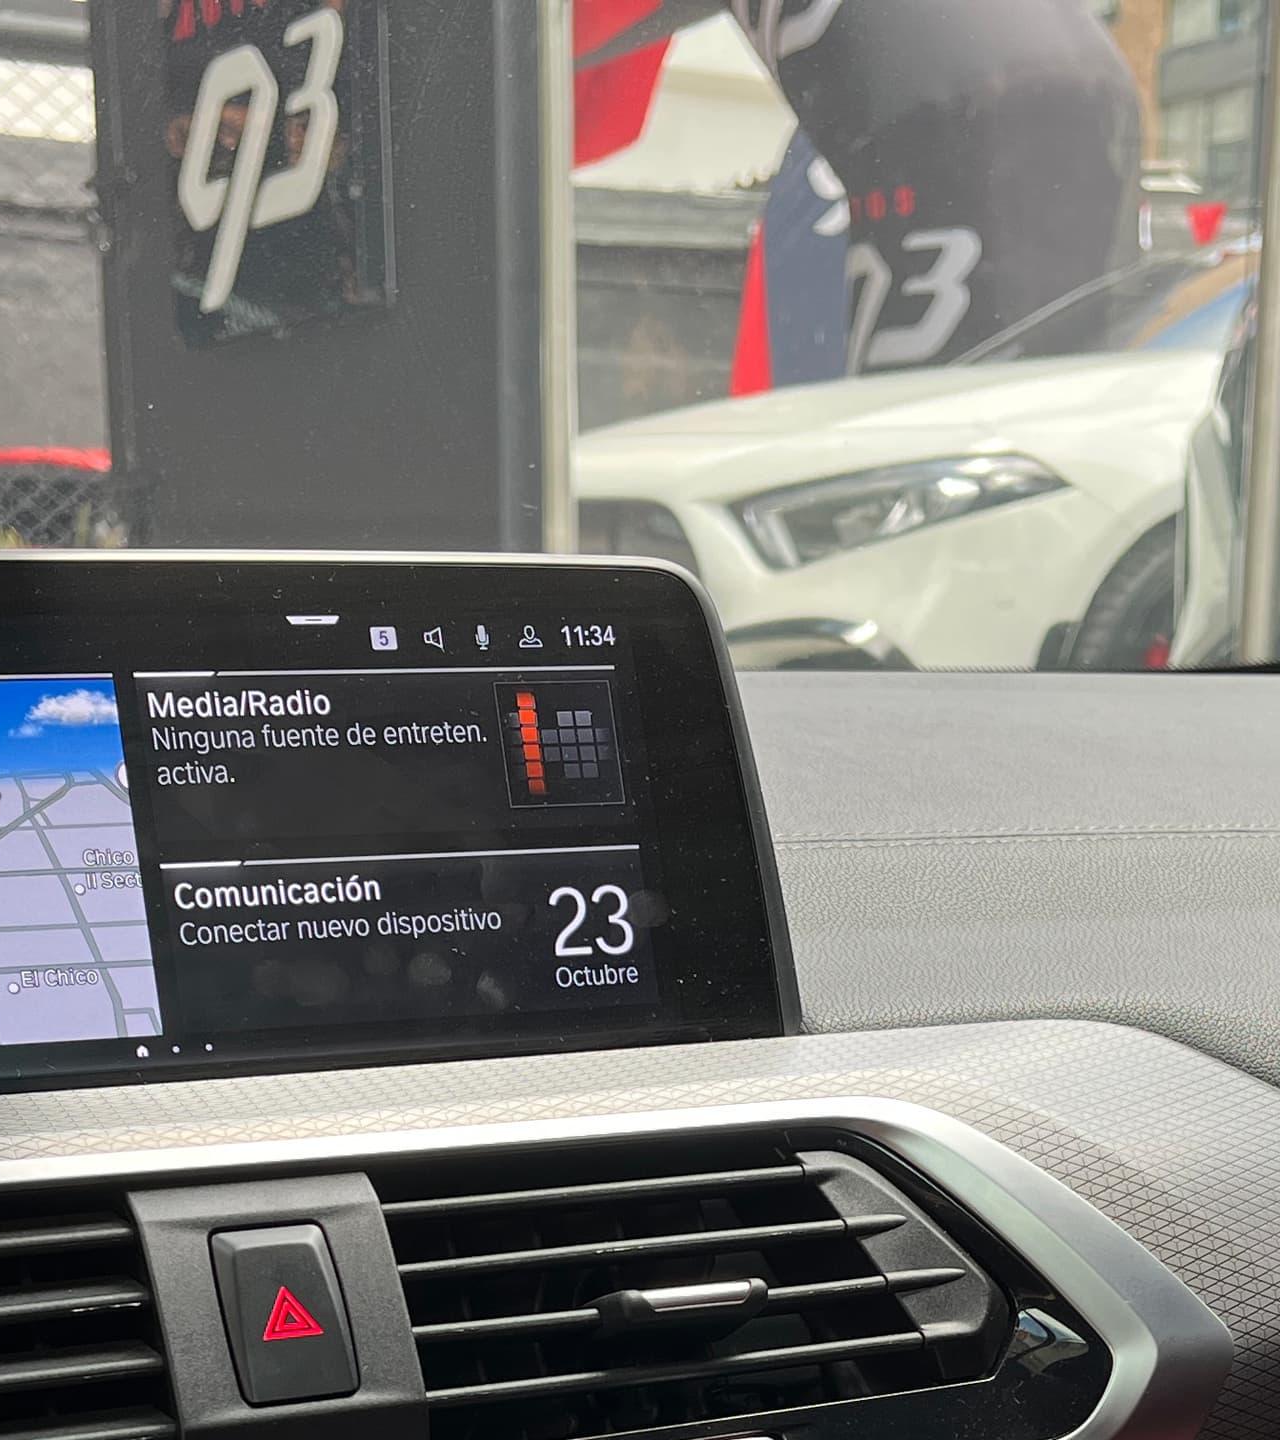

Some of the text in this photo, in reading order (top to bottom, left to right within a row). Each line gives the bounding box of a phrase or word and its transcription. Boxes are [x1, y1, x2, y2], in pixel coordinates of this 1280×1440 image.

[177, 7, 343, 313] 93
[378, 629, 389, 647] 5
[560, 625, 616, 646] 11:34
[147, 690, 331, 718] Media/Radio
[152, 722, 488, 753] Ninguna fuente de entreten.
[157, 763, 236, 785] activa.
[83, 849, 134, 866] Chico
[101, 871, 143, 889] Sect
[174, 876, 381, 910] Comunicación
[180, 908, 503, 946] Conectar nuevo dispositivo
[549, 885, 634, 957] 23
[20, 968, 98, 988] El Chico
[555, 962, 639, 989] Octubre
